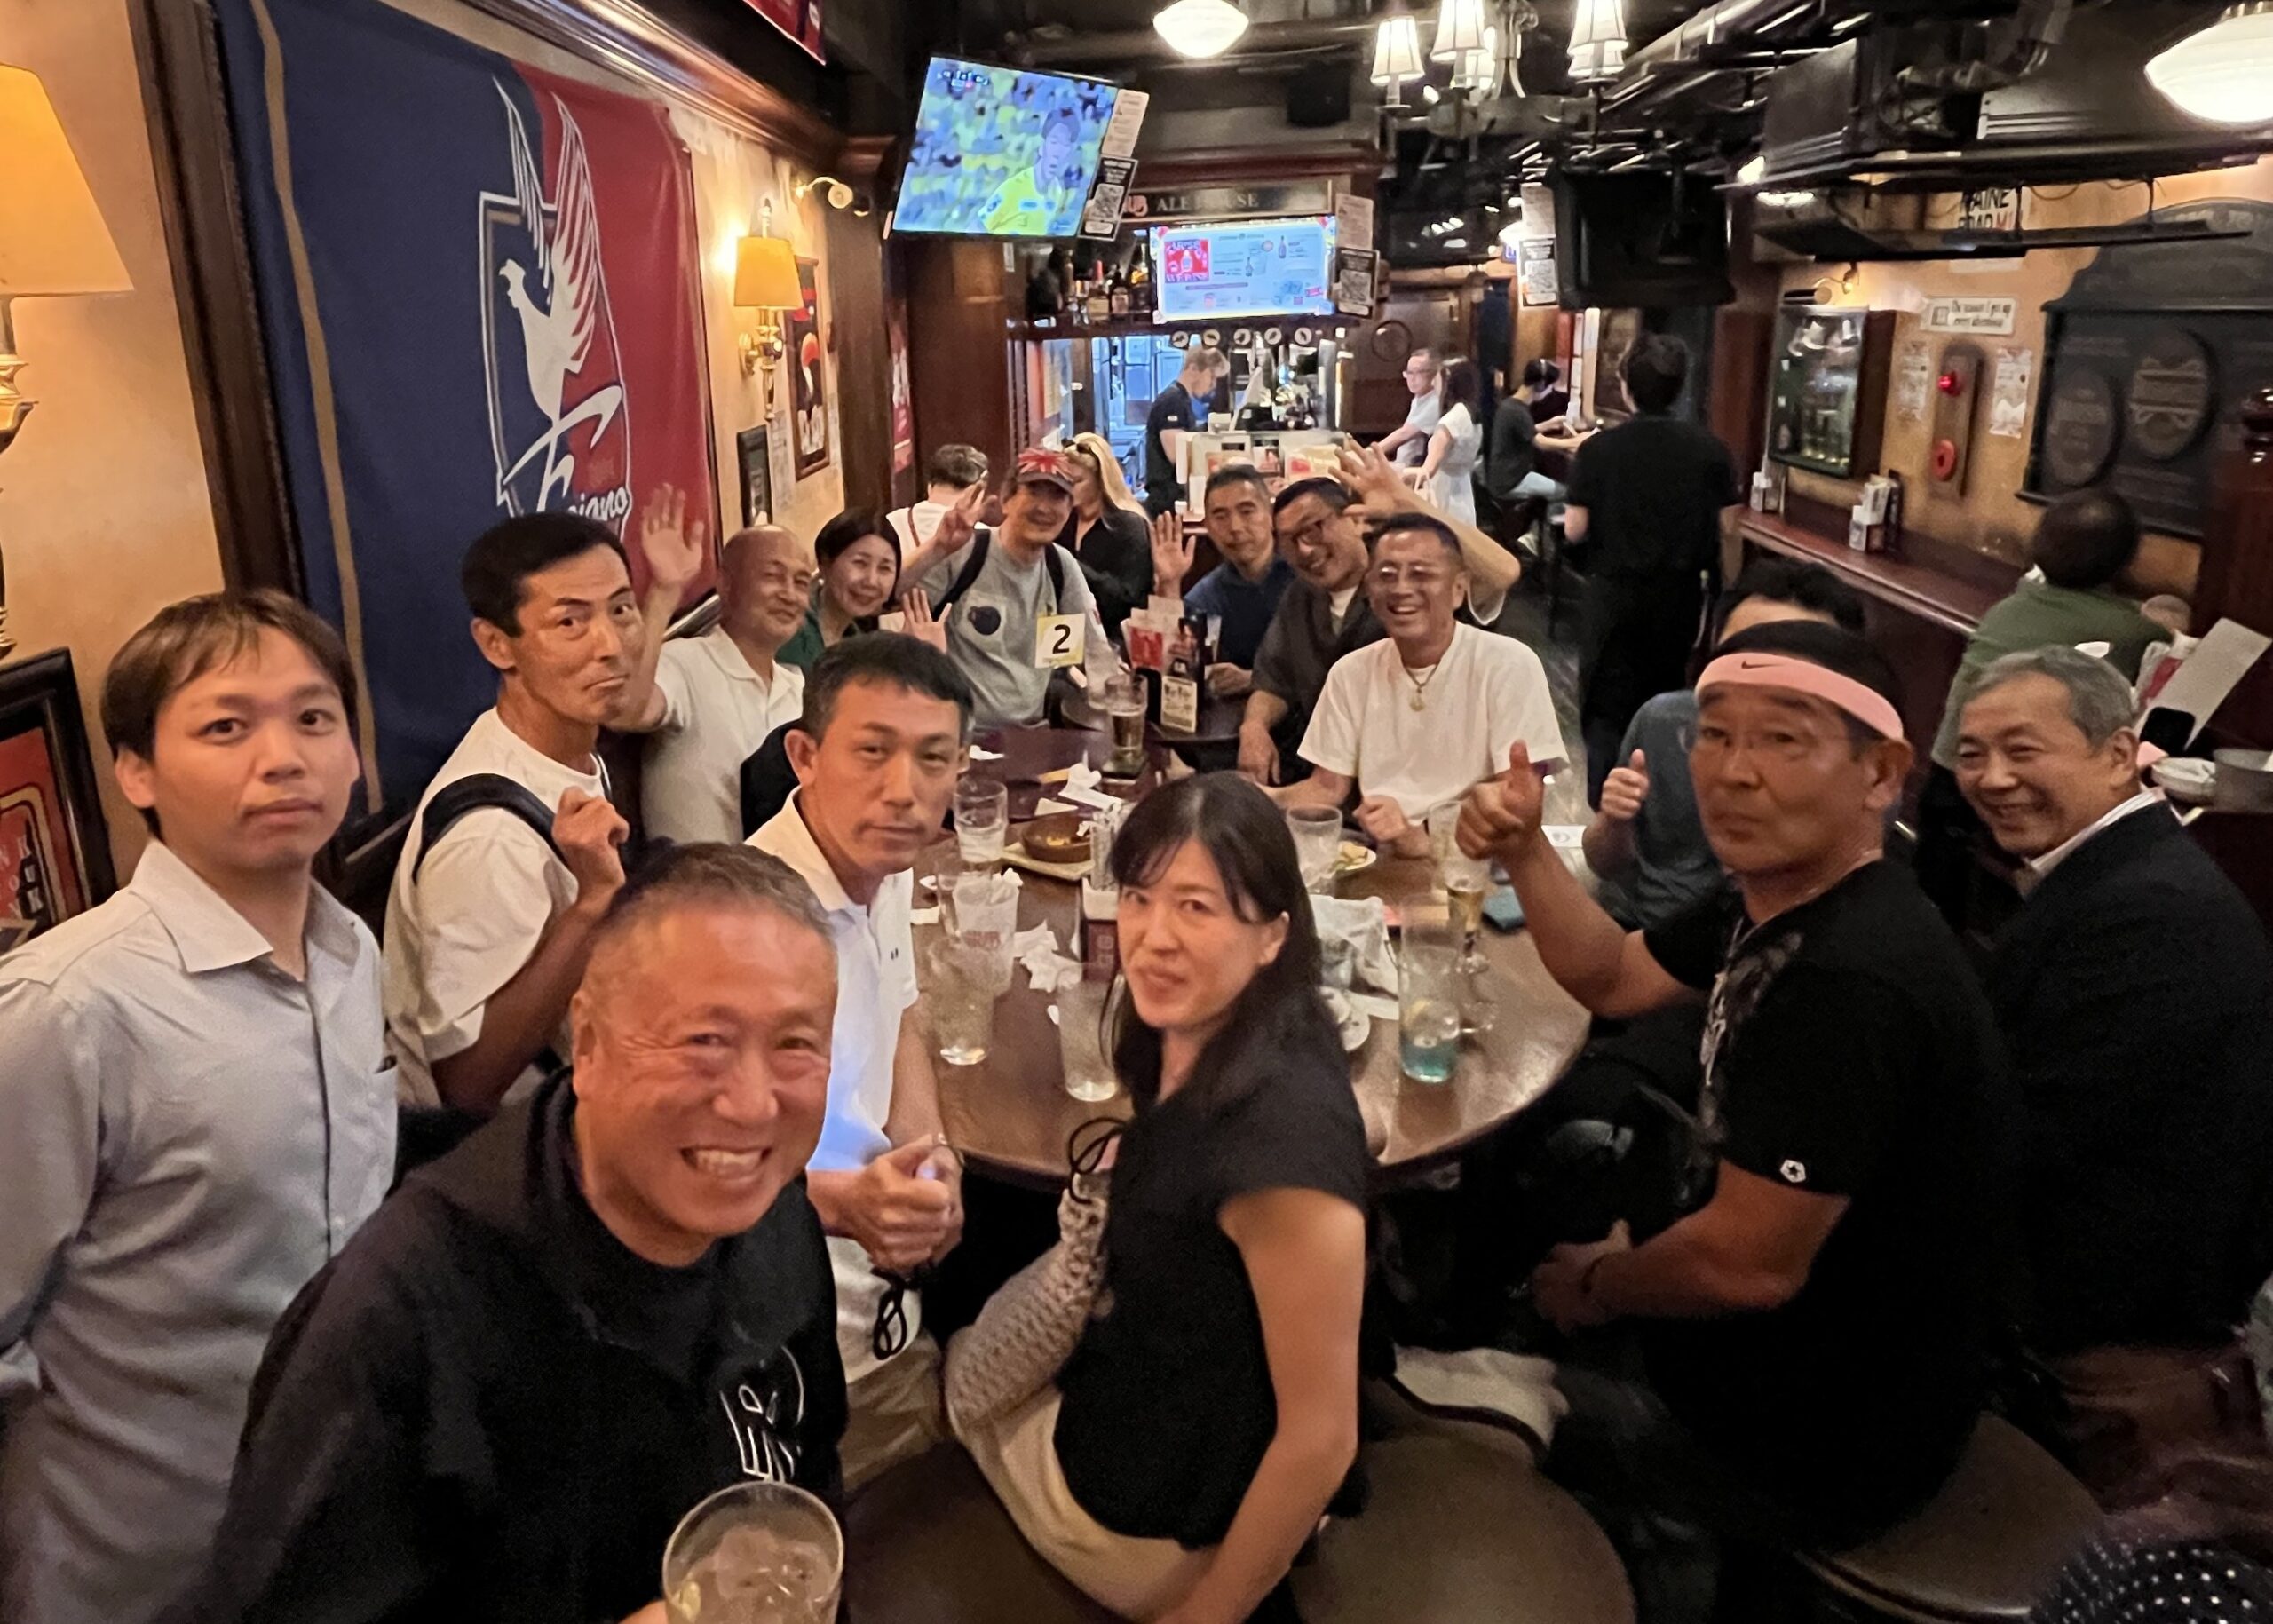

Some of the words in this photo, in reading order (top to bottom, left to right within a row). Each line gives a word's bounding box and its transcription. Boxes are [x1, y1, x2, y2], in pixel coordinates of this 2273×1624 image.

[1156, 196, 1190, 211] ALE
[1194, 194, 1259, 210] USE
[1961, 187, 2009, 211] AINE
[1052, 624, 1071, 654] 2
